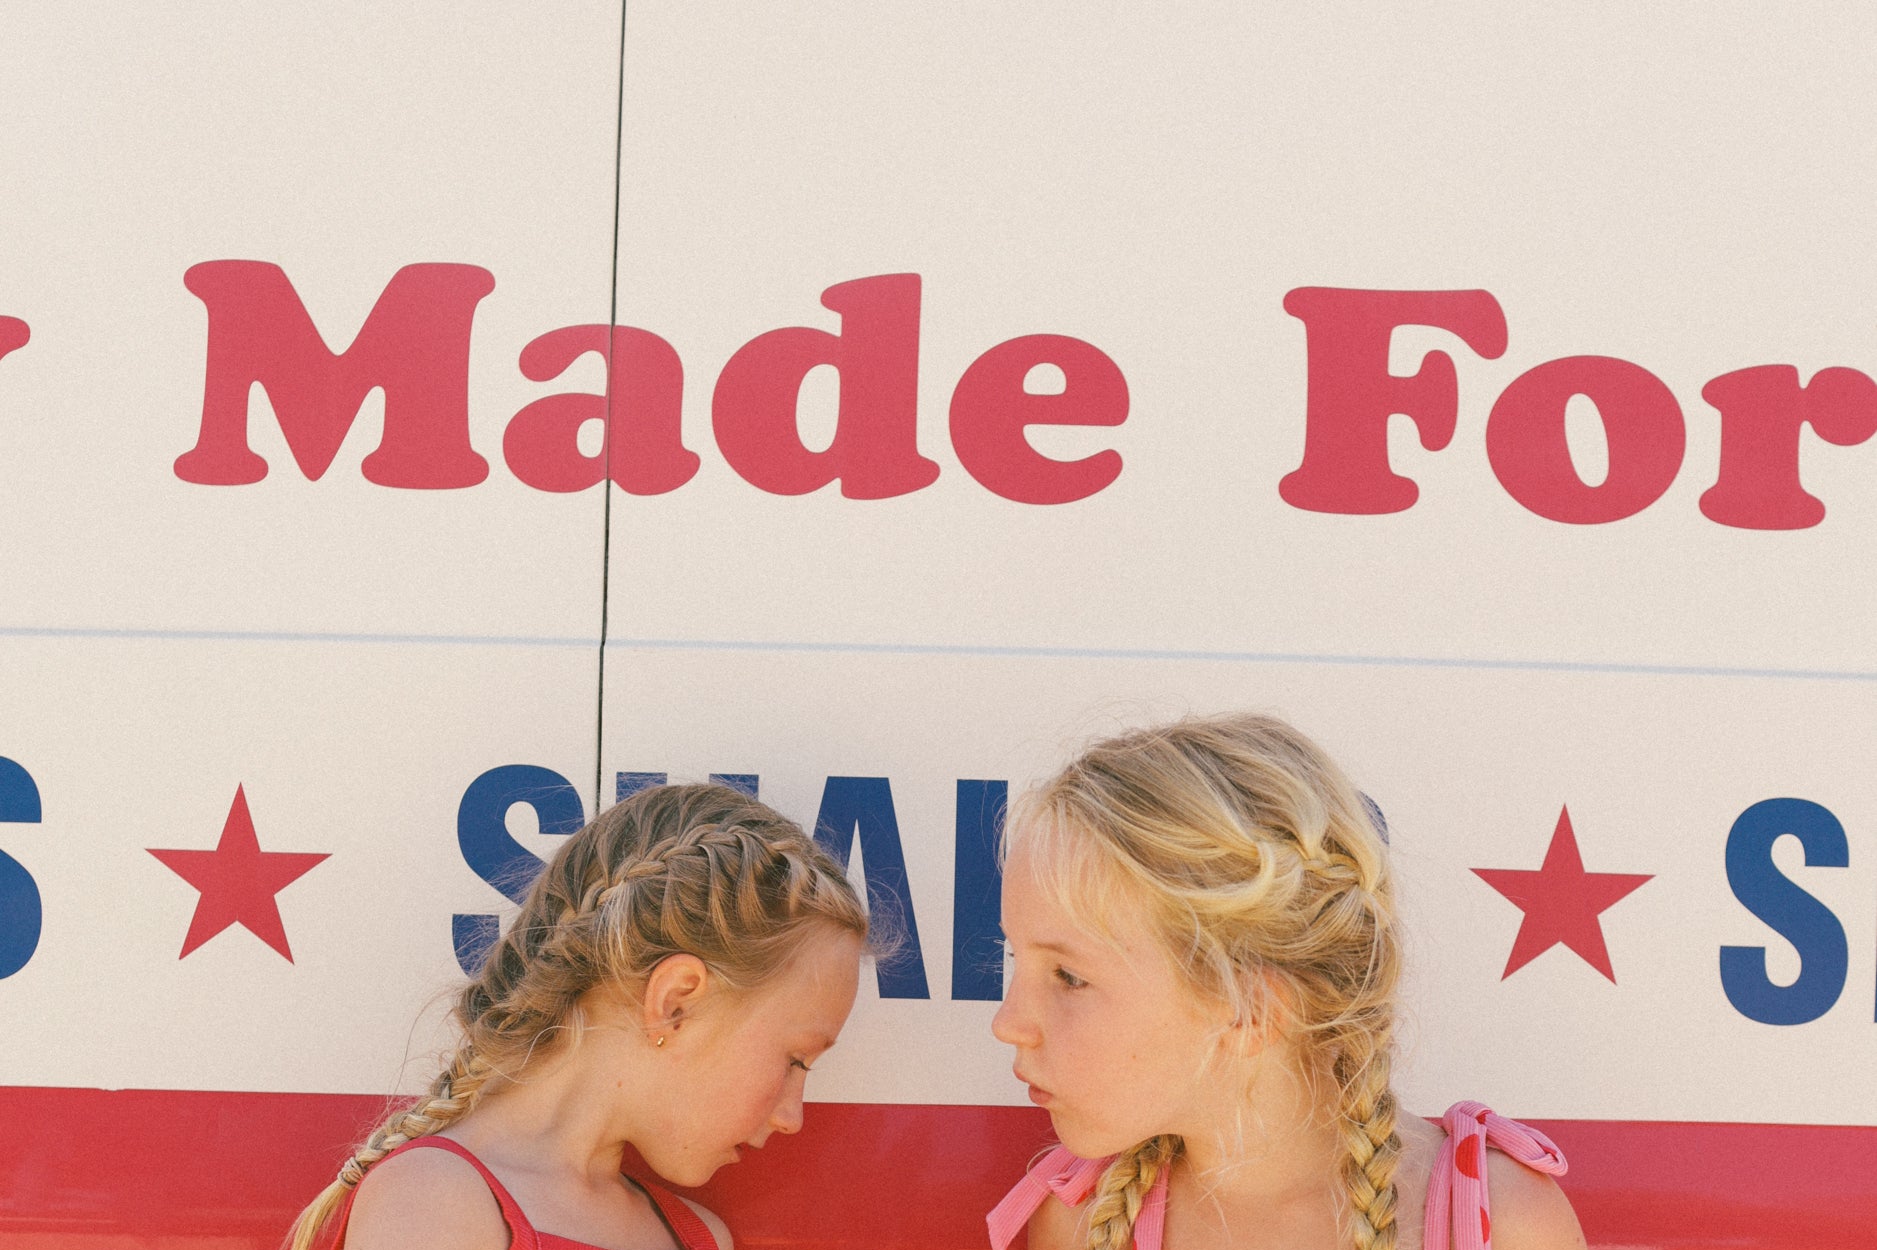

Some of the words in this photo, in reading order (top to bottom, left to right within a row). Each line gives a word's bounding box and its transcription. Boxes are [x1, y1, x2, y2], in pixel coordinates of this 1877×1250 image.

[174, 259, 1130, 506] Made
[1278, 286, 1877, 531] For
[1719, 797, 1877, 1026] S
